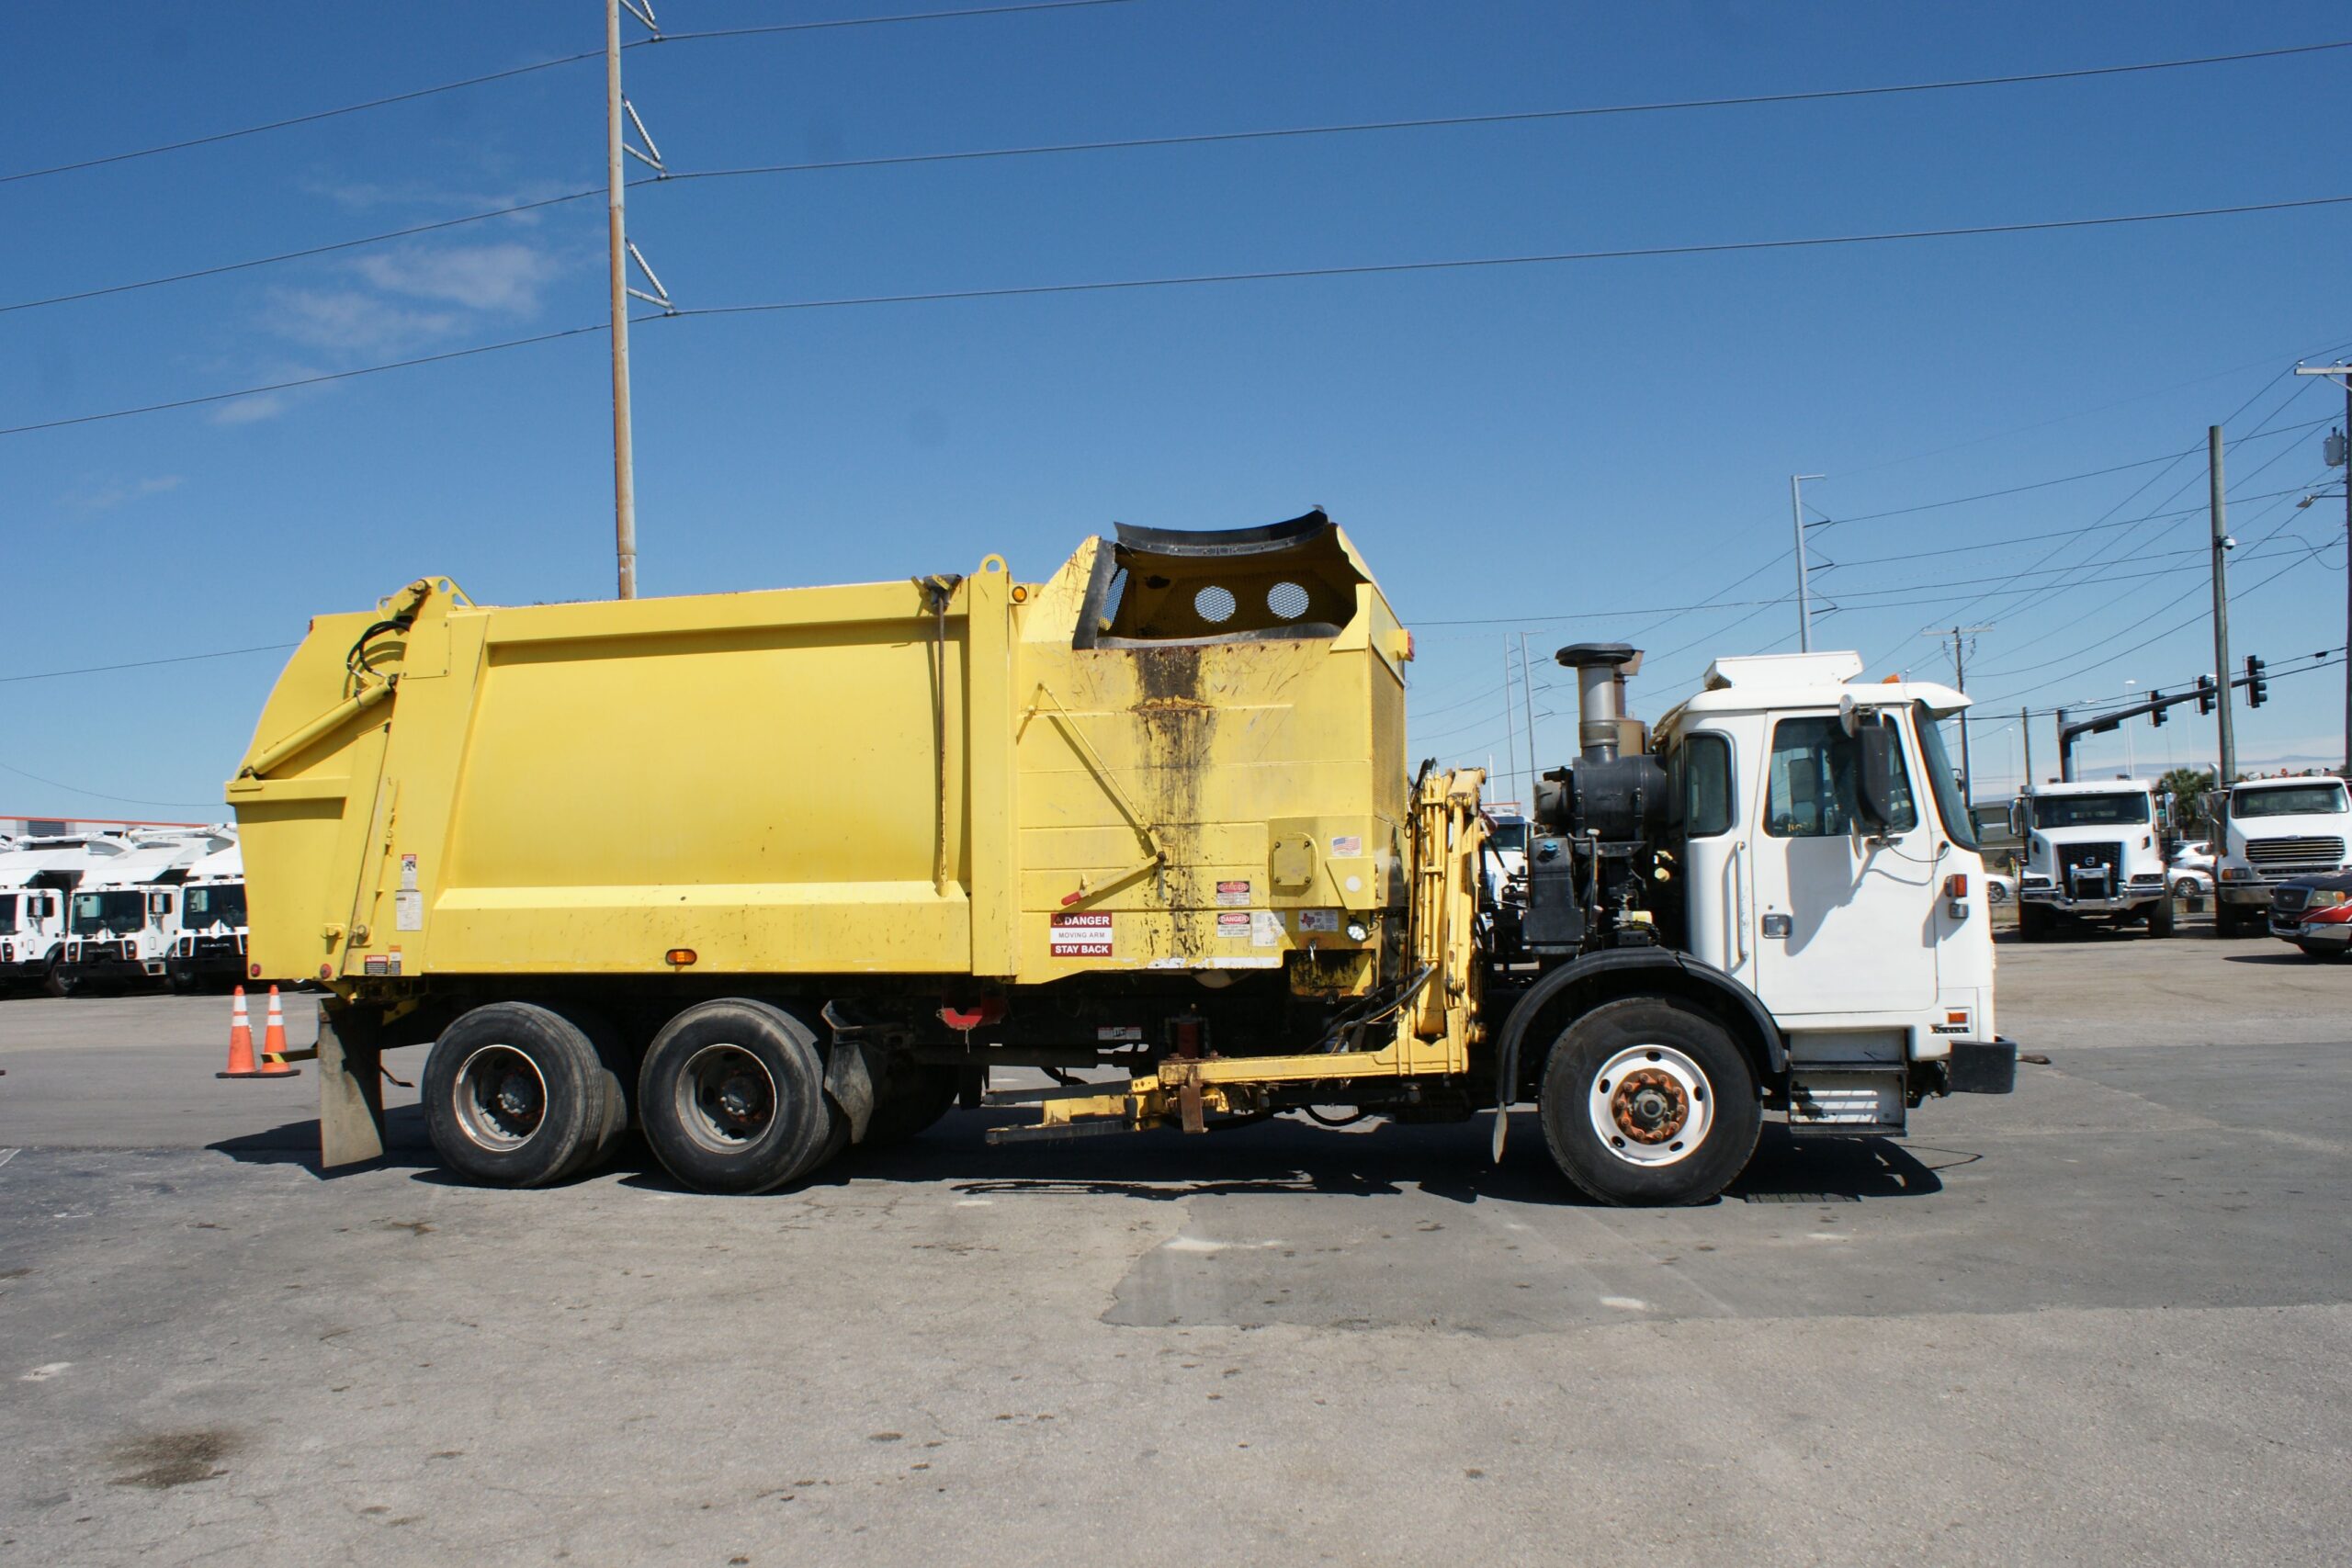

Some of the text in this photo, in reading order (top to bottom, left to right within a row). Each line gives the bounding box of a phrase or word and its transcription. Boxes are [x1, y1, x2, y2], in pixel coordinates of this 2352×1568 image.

[1064, 916, 1110, 925] DANGER
[1055, 945, 1109, 953] STAY BACK
